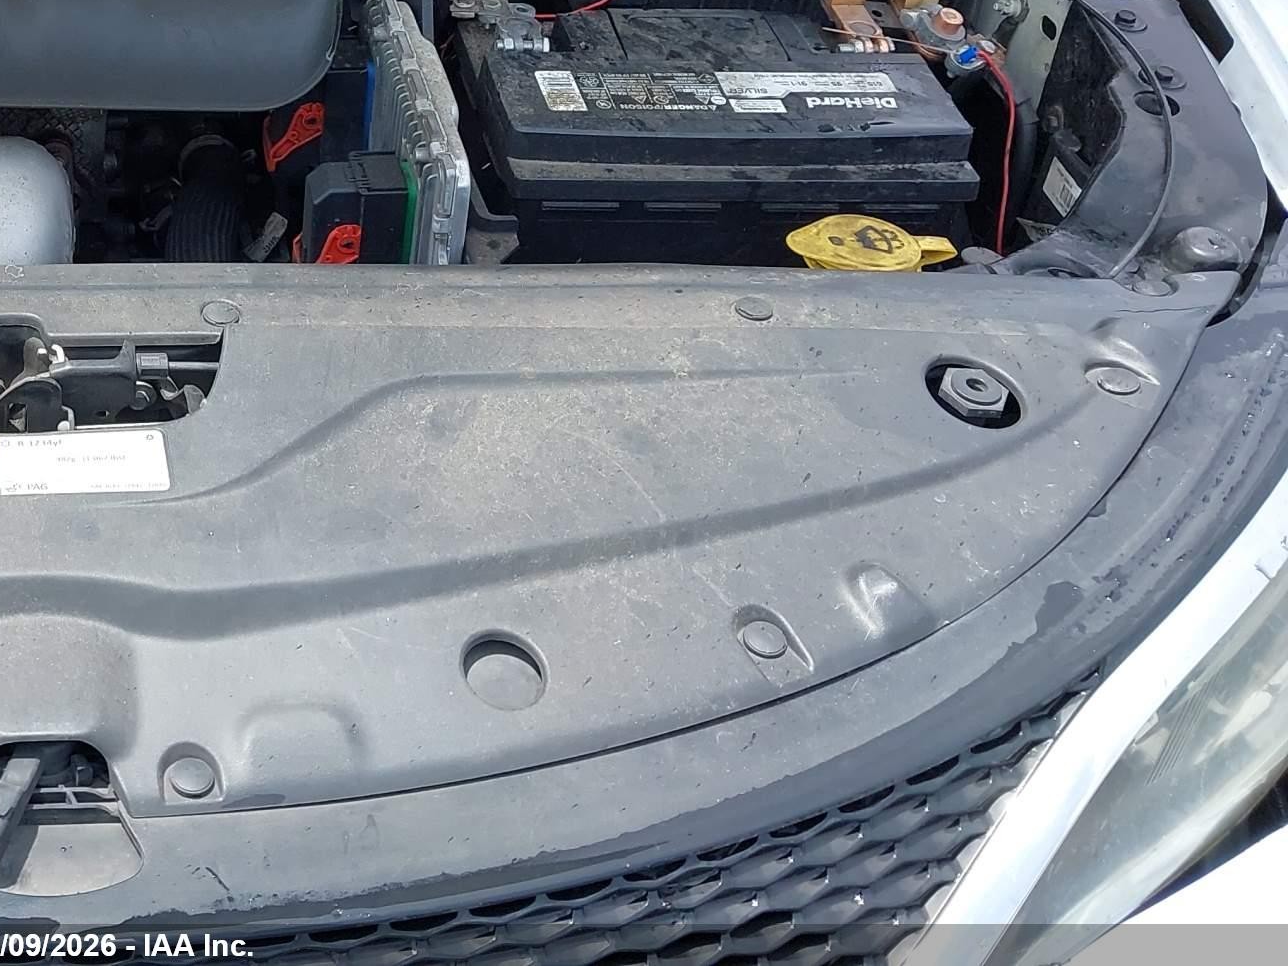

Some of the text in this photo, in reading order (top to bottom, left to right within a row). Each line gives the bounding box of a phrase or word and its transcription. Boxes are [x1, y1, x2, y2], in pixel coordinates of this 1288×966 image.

[728, 87, 768, 95] SILVER
[805, 96, 899, 109] DieHard
[26, 482, 49, 491] PAG
